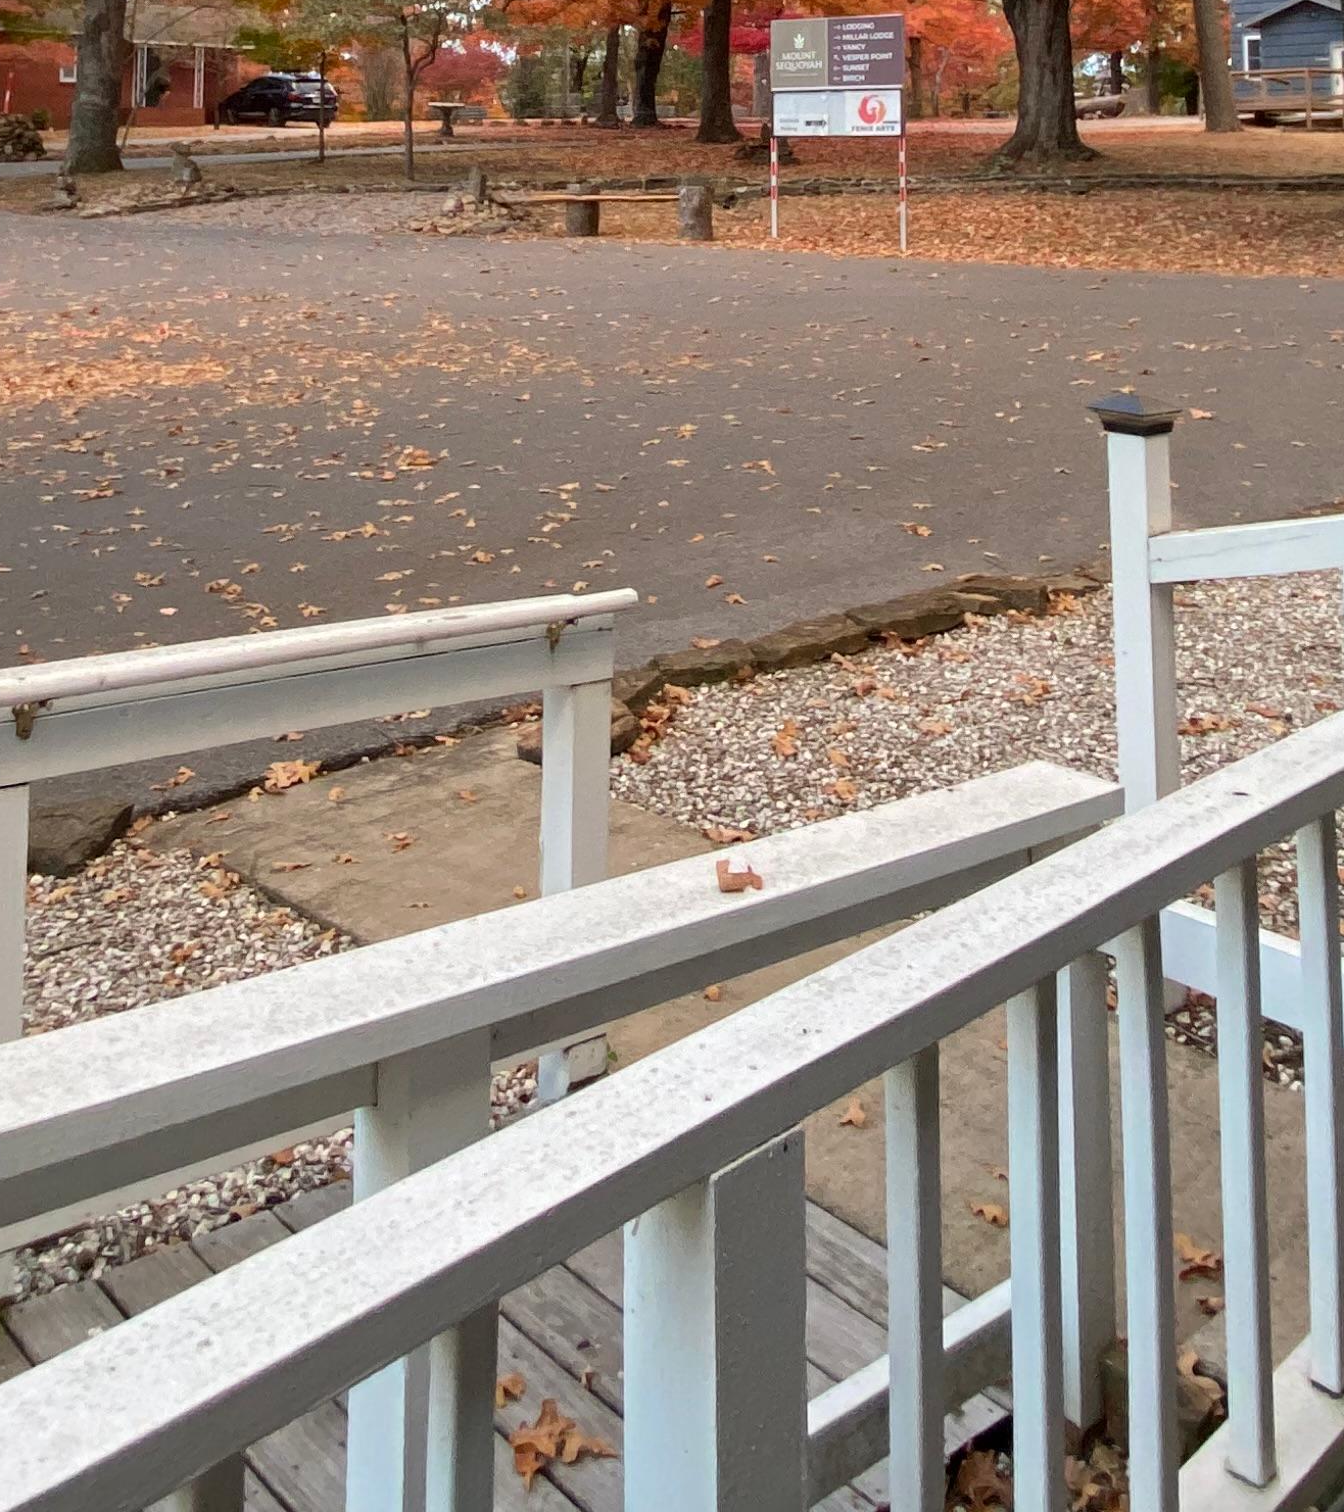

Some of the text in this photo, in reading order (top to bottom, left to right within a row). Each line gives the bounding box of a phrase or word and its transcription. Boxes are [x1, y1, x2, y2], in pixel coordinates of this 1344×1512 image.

[842, 22, 875, 31] LODGING
[869, 31, 895, 40] LODGE
[782, 51, 816, 61] MOUNT
[842, 52, 893, 62] VESPER POINT
[776, 60, 823, 72] SEQUOYAH
[842, 63, 870, 71] SUNSET
